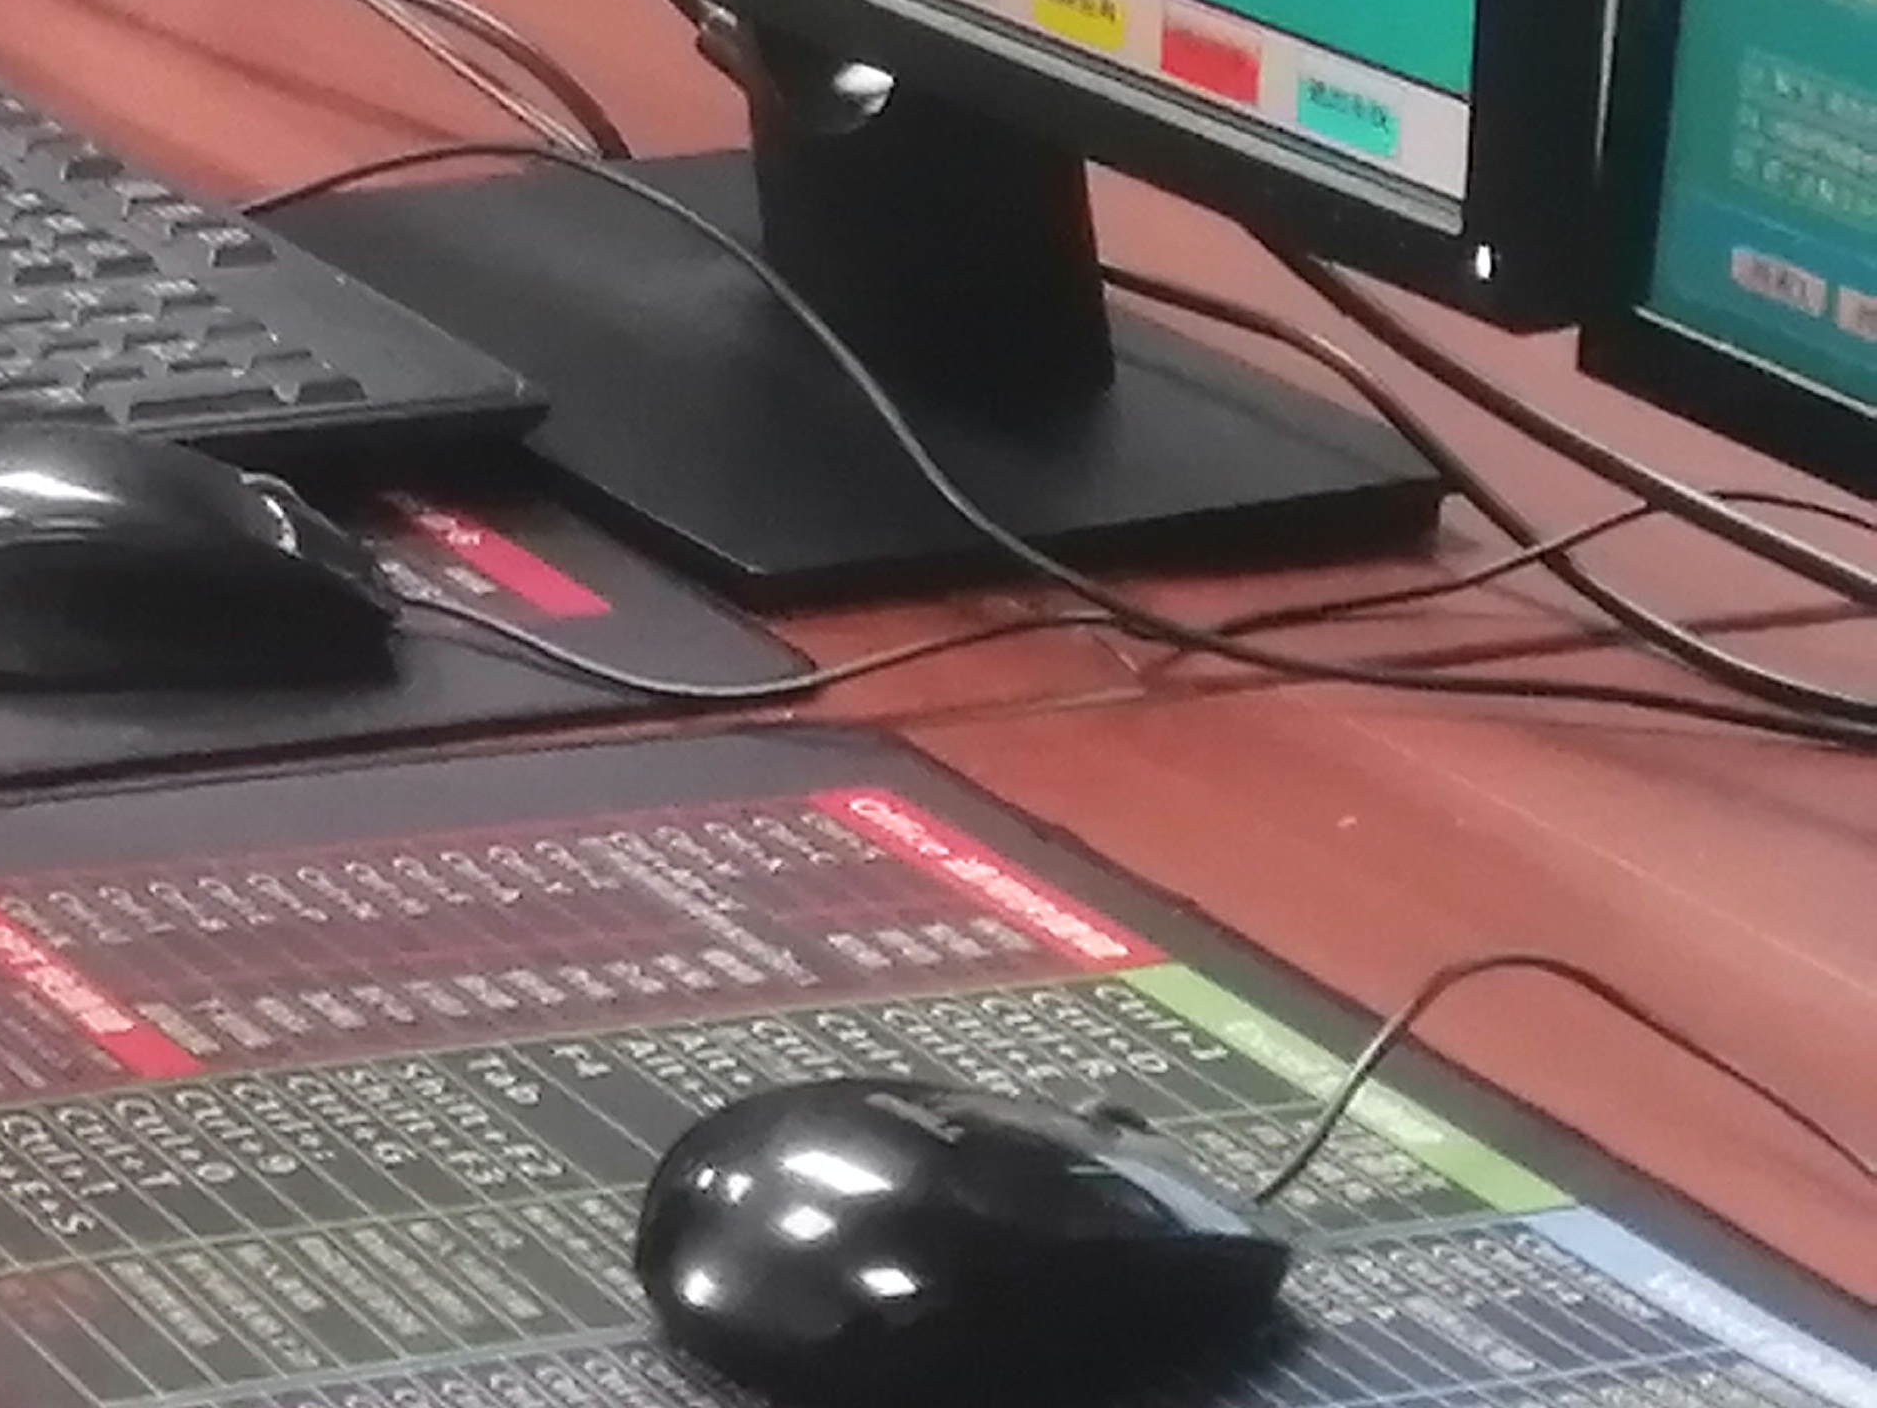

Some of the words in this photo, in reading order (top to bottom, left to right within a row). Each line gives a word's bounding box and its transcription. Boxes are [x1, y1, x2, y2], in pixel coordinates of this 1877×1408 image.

[1032, 992, 1168, 1074] Ctrl+D
[288, 1077, 417, 1163] Ctrl+G
[392, 1063, 562, 1176] Shift+F2
[468, 1054, 539, 1103] Tab
[56, 1107, 181, 1192] Ctrl+T
[175, 1090, 296, 1173] Ctrl+9
[338, 1070, 506, 1184] Shift+F3
